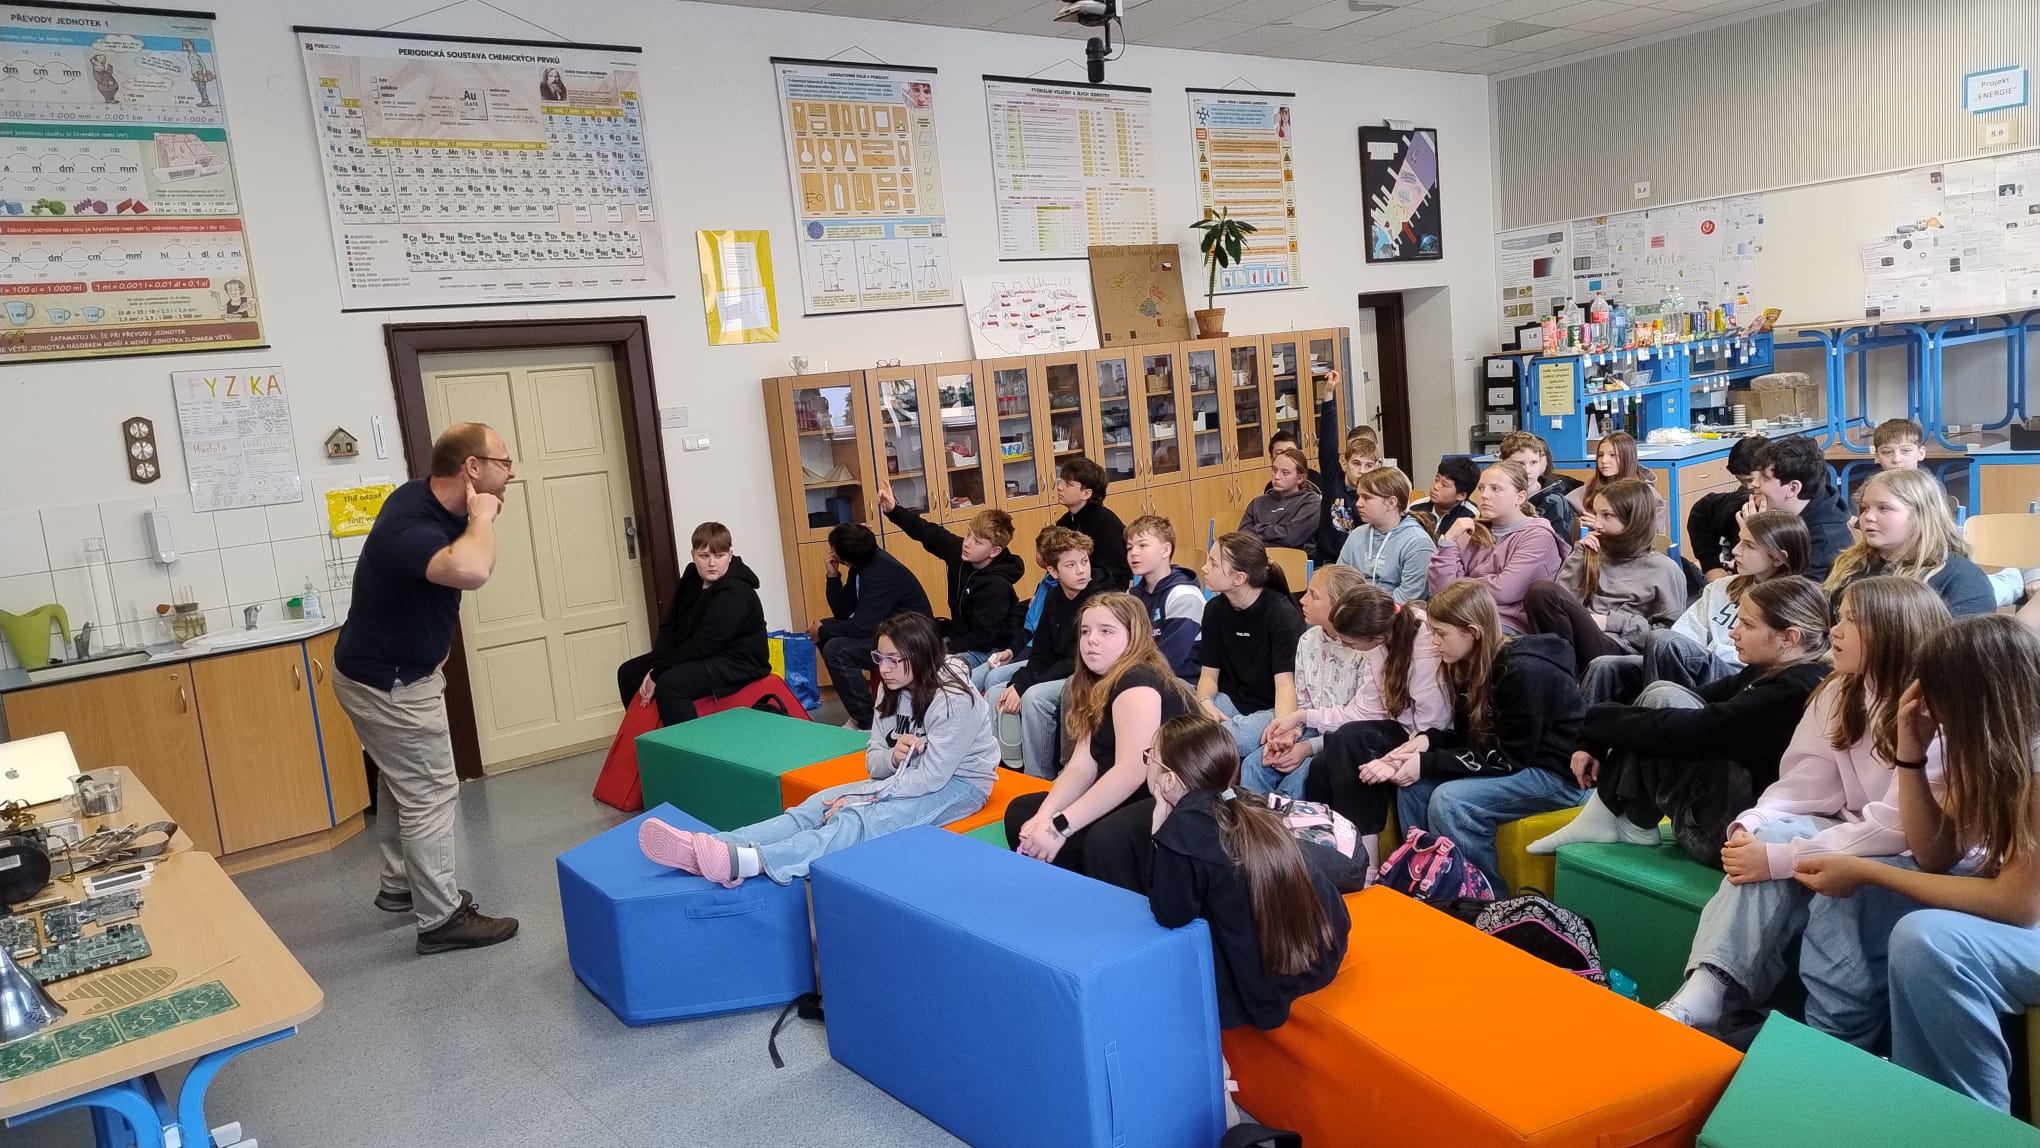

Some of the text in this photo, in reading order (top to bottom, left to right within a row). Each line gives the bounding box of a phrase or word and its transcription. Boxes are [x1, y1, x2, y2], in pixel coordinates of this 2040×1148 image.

[10, 14, 53, 23] PŘEVODY
[56, 18, 101, 27] JEDNOTEK
[398, 48, 560, 64] PERIODICKÁ SOUSTAVA CHEMICKÝCH PRVKŮ
[3, 65, 18, 74] dm
[63, 69, 81, 77] mm
[1981, 77, 2010, 88] Projekt
[463, 91, 476, 100] Au
[1974, 87, 2017, 102] „ENERGIE“
[350, 128, 361, 136] Mg
[440, 205, 448, 213] Sg
[8, 344, 28, 352] VĚTŠÍ
[67, 342, 102, 350] NÁSOBKEM
[188, 375, 282, 398] FYZIKA
[193, 443, 227, 453] Hustota
[343, 494, 357, 503] Tříď
